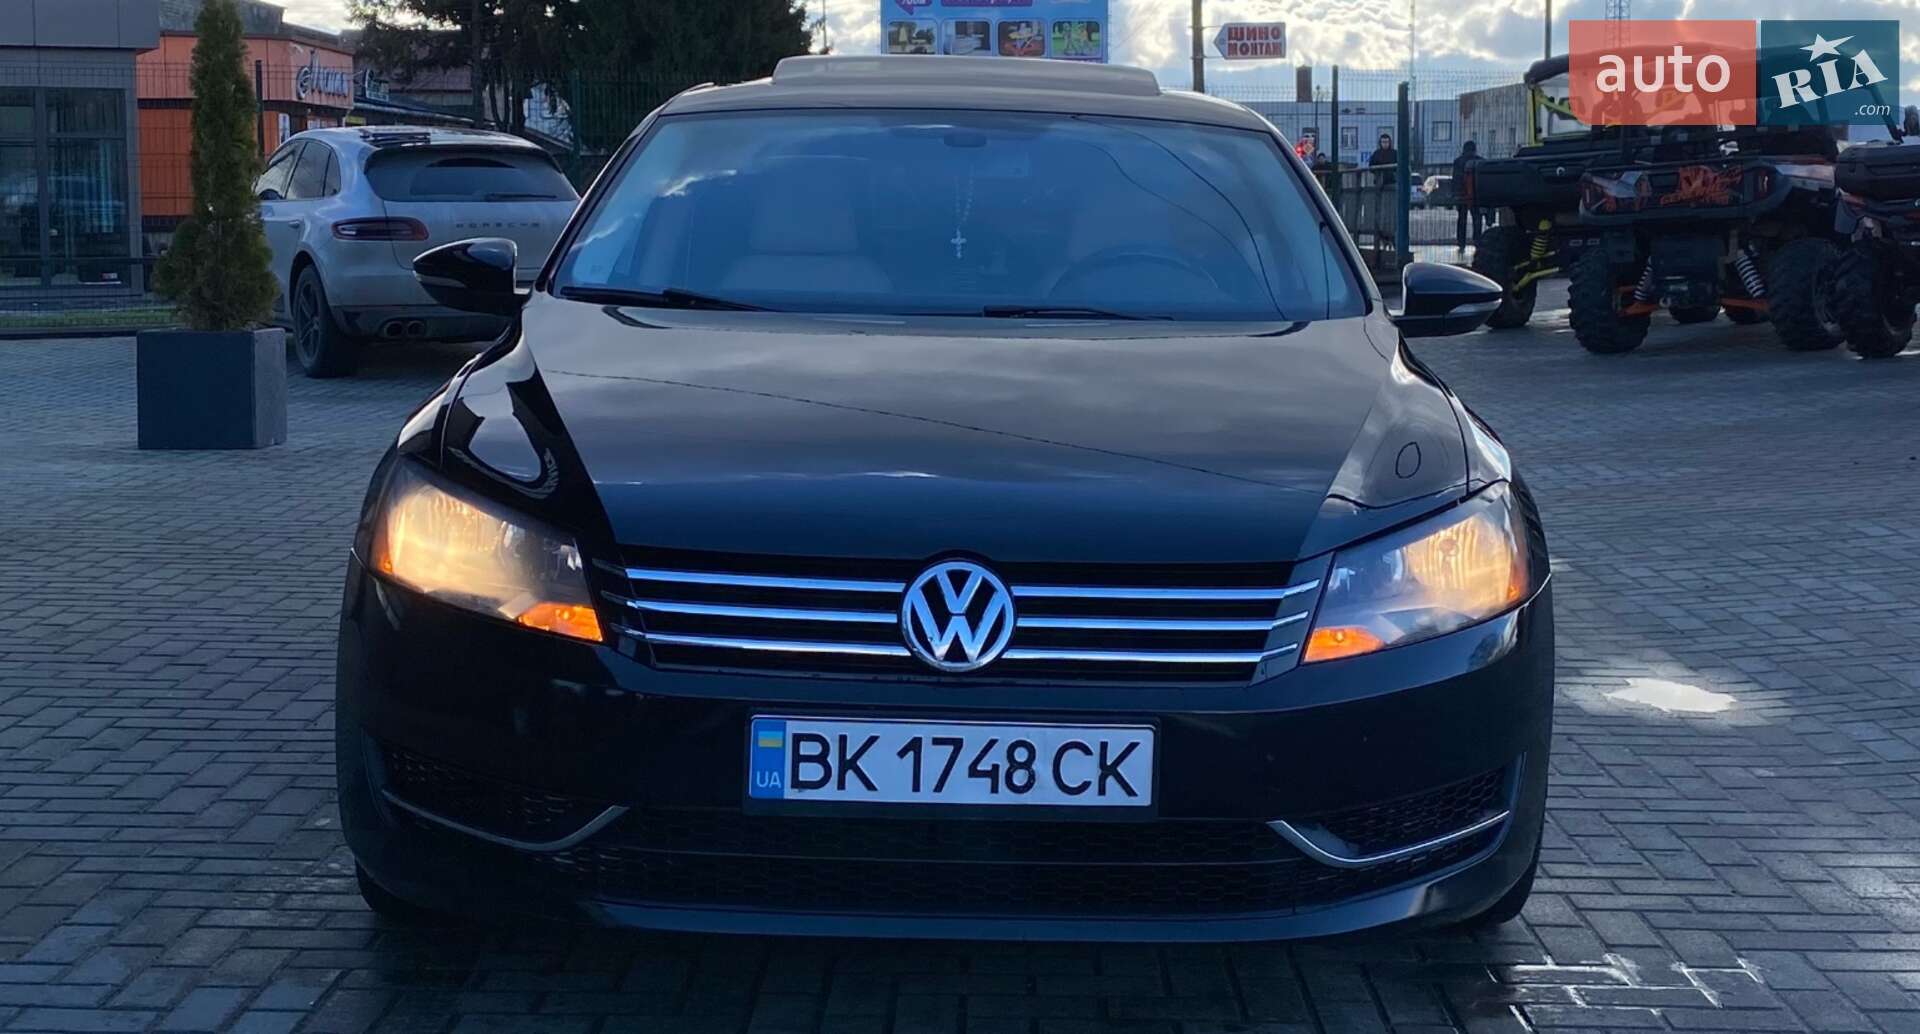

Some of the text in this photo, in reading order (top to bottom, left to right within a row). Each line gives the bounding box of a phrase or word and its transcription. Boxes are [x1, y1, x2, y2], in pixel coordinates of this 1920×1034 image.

[1227, 26, 1281, 41] ШИНО
[1227, 42, 1281, 56] МОНТАЖ
[790, 732, 1141, 798] BK 1748 CK
[756, 770, 782, 790] UA
